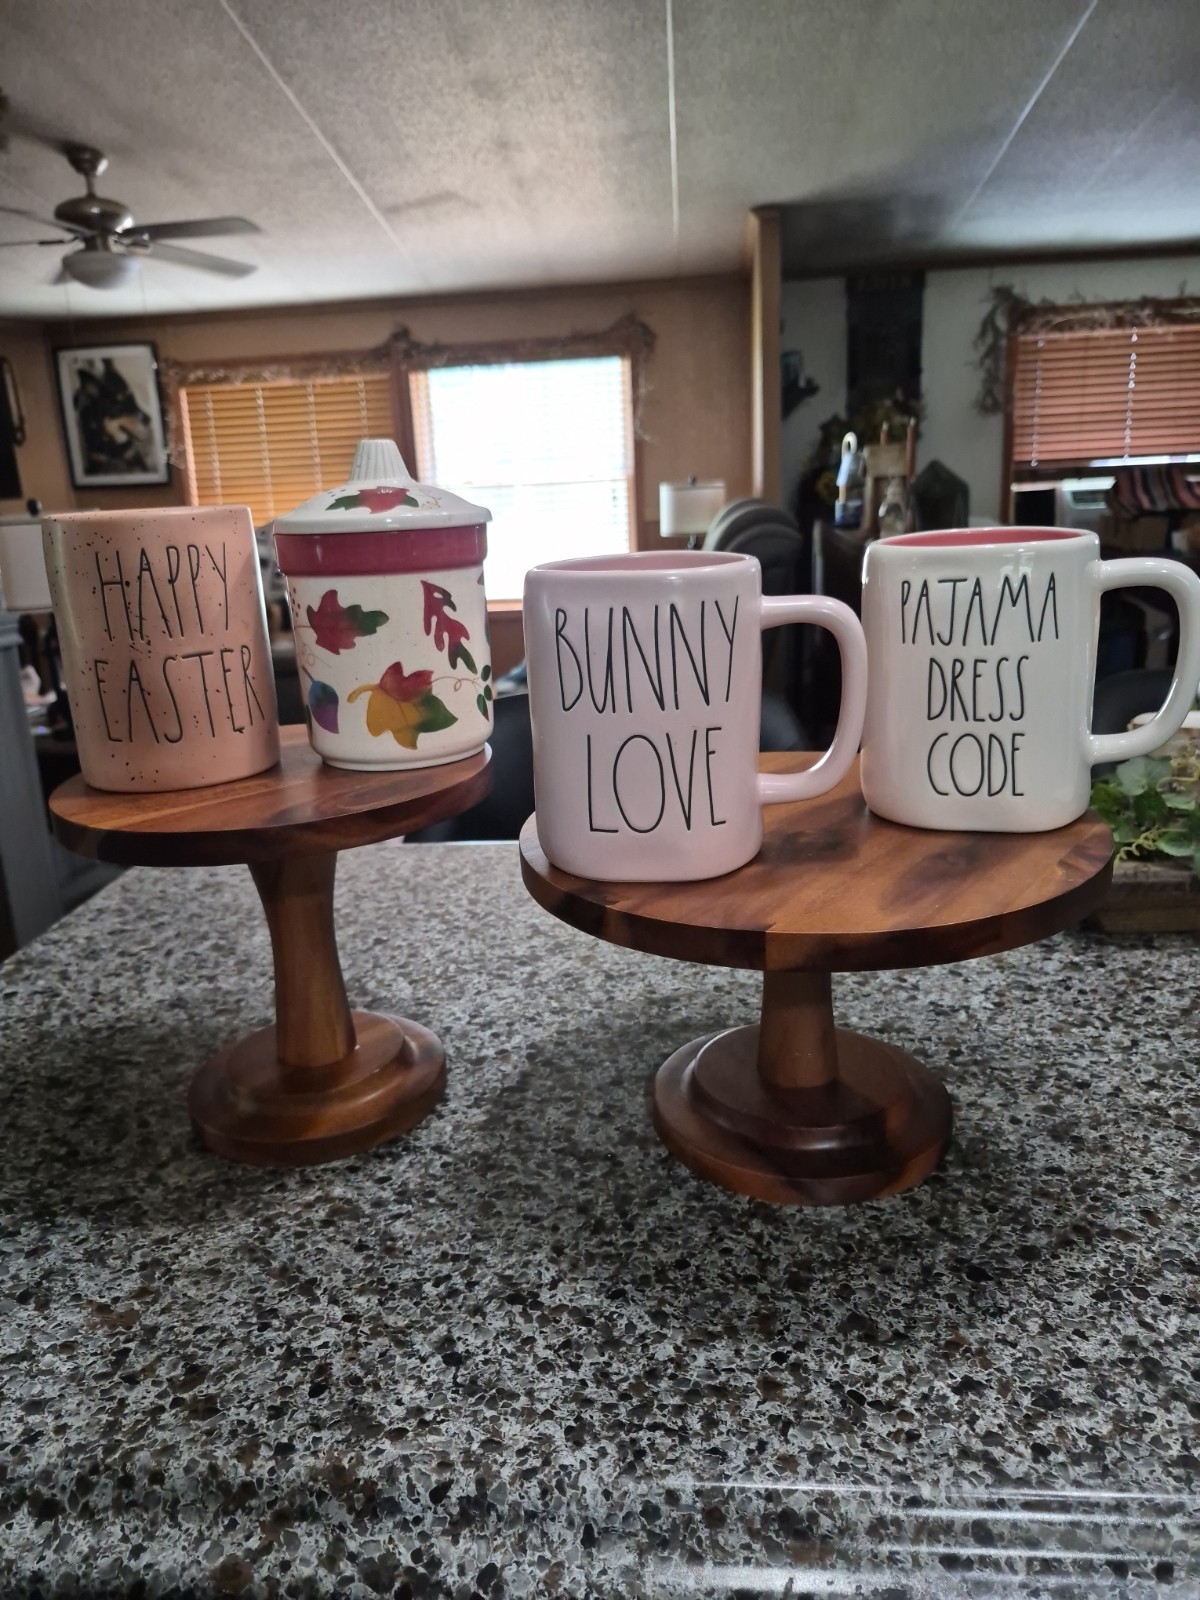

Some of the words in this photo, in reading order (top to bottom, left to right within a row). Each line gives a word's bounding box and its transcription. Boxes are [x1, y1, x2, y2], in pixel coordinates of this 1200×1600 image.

[95, 542, 229, 642] HAPPY
[901, 572, 1059, 647] PAJAMA
[94, 645, 265, 744] EASTER
[555, 595, 739, 714] BUNNY
[927, 655, 1030, 722] DRESS
[587, 727, 726, 833] LOVE
[926, 733, 1025, 797] CODE
